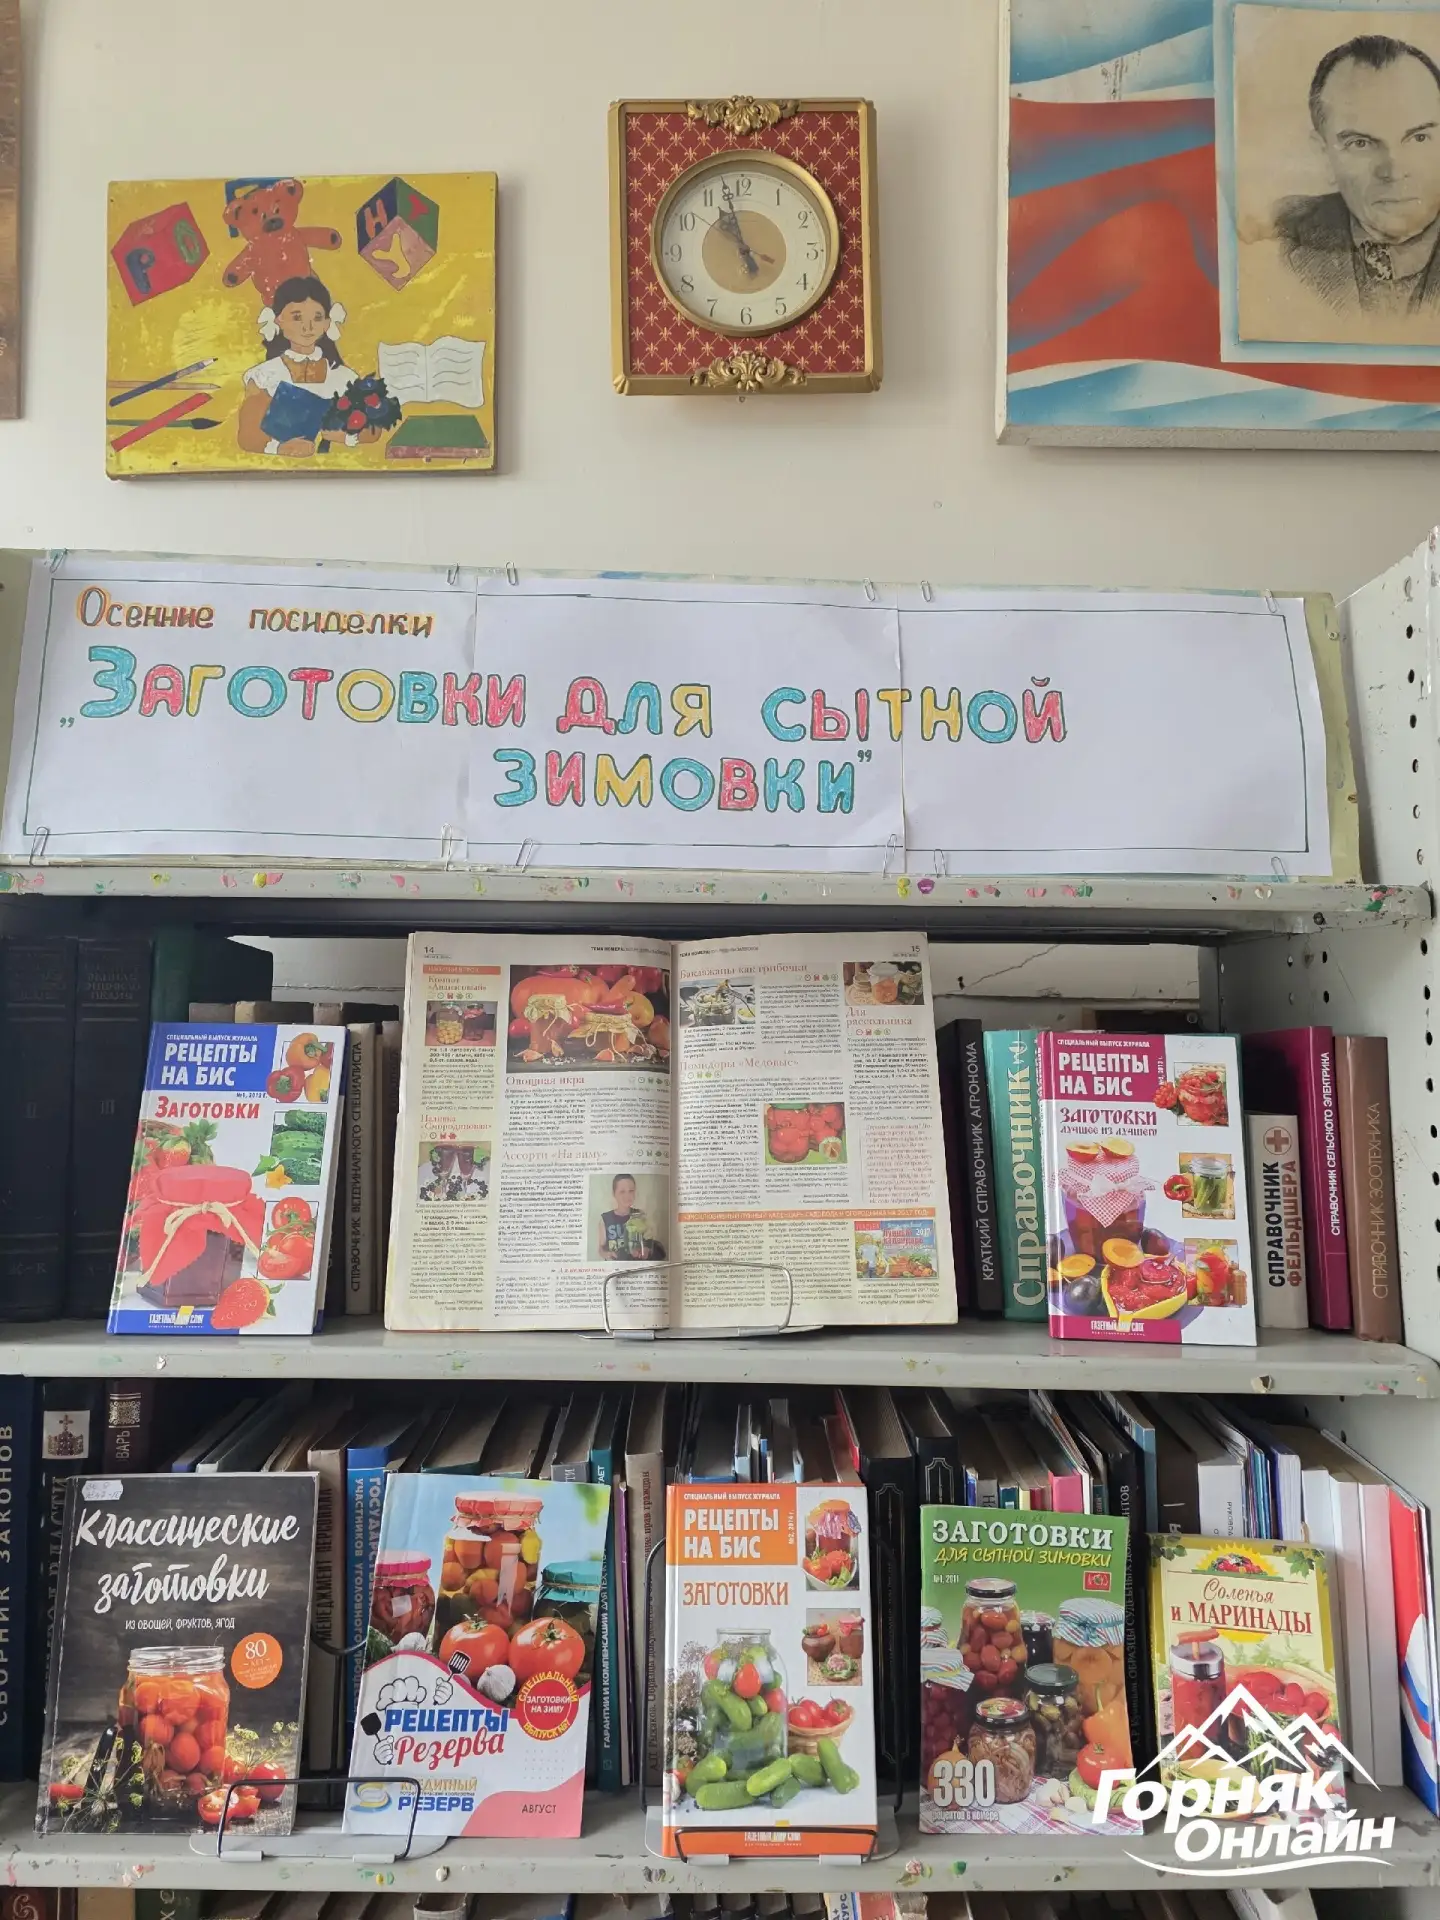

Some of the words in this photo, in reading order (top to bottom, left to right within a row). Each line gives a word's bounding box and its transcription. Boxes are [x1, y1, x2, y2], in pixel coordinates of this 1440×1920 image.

[703, 190, 714, 206] 11
[735, 178, 752, 197] 12
[775, 190, 781, 205] 1
[679, 213, 696, 231] 10
[797, 211, 809, 228] 2
[669, 244, 682, 262] 9
[806, 242, 819, 260] 3
[680, 275, 694, 293] 8
[796, 273, 808, 290] 4
[707, 299, 718, 317] 7
[740, 307, 752, 325] 6
[775, 298, 787, 315] 5
[77, 587, 215, 629] Осенние
[249, 608, 434, 640] посиделки
[424, 946, 434, 954] 14
[165, 1043, 258, 1065] РЕЦЕПТЫ
[1057, 1039, 1099, 1047] СПЕЦИАЛЬНЫЙ
[161, 1066, 189, 1085] НА
[195, 1066, 236, 1086] БИС
[1058, 1052, 1150, 1075] РЕЦЕПТЫ
[352, 1041, 363, 1121] СПЕЦИАЛИСТА
[506, 1076, 557, 1087] Овощная
[560, 1076, 585, 1085] икра
[965, 1042, 981, 1119] АГРОНОМА
[1059, 1076, 1088, 1095] НА
[1093, 1077, 1133, 1096] БИС
[1320, 1052, 1333, 1107] ЭЛЕКТРИКА
[1060, 1107, 1157, 1126] ЗАГОТОВКИ
[1325, 1109, 1337, 1166] СЕЛЬСКОГО
[502, 1150, 548, 1161] Ассорти
[1367, 1102, 1386, 1199] ЗООТЕХНИКА
[351, 1123, 362, 1214] ВЕТЕРИНАРНОГО
[971, 1123, 989, 1214] СПРАВОЧНИК
[1007, 1067, 1046, 1306] Справочник
[1329, 1168, 1341, 1236] СПРАВОЧНИК
[1263, 1162, 1285, 1287] СПРАВОЧНИК
[1281, 1160, 1303, 1287] ФЕЛЬДШЕРА
[350, 1216, 362, 1292] СПРАВОЧНИК
[980, 1220, 994, 1281] КРАТКИЙ
[1371, 1203, 1389, 1298] СПРАВОЧНИК
[116, 1430, 130, 1462] ВАРЬ
[0, 1425, 13, 1563] ЗАКОНОВ
[683, 1493, 727, 1501] СПЕЦИАЛЬНЫЙ
[75, 1508, 300, 1548] Классические
[354, 1478, 364, 1557] УЧАСТНИКОВ
[684, 1508, 779, 1536] РЕЦЕПТЫ
[932, 1519, 1114, 1550] ЗАГОТОВКИ
[684, 1536, 713, 1559] НА
[719, 1536, 761, 1559] БИС
[934, 1547, 968, 1564] ДЛЯ
[972, 1547, 1034, 1563] СЫТНОЙ
[1038, 1551, 1112, 1567] ЗИМОВКИ
[94, 1553, 271, 1614] заготовки
[683, 1582, 789, 1606] ЗАГОТОВКИ
[1203, 1578, 1275, 1604] Соленья
[316, 1559, 333, 1641] МЕНЕДЖМЕНТ
[354, 1562, 363, 1643] УГОЛОВНОГО
[215, 1617, 235, 1629] ЯГОД
[1170, 1606, 1181, 1621] и
[1188, 1602, 1313, 1635] МАРИНАДЫ
[245, 1639, 267, 1659] 80
[601, 1613, 610, 1686] КОМПЕНСАЦИИ
[1126, 1629, 1138, 1679] ОБРАЗЦЫ
[518, 1670, 580, 1703] СПЕЦИАЛЬНЫЙ
[602, 1687, 610, 1695] И
[526, 1696, 571, 1704] ЗАГОТОВКИ
[530, 1705, 544, 1713] НА
[545, 1705, 564, 1713] ЗИМУ
[384, 1708, 510, 1733] РЕЦЕПТЫ
[523, 1721, 559, 1739] ВЫПУСК
[602, 1696, 611, 1748] ГАРАНТИИ
[394, 1726, 505, 1770] Резерва
[933, 1759, 996, 1807] 330
[521, 1803, 556, 1814] АВГУСТ
